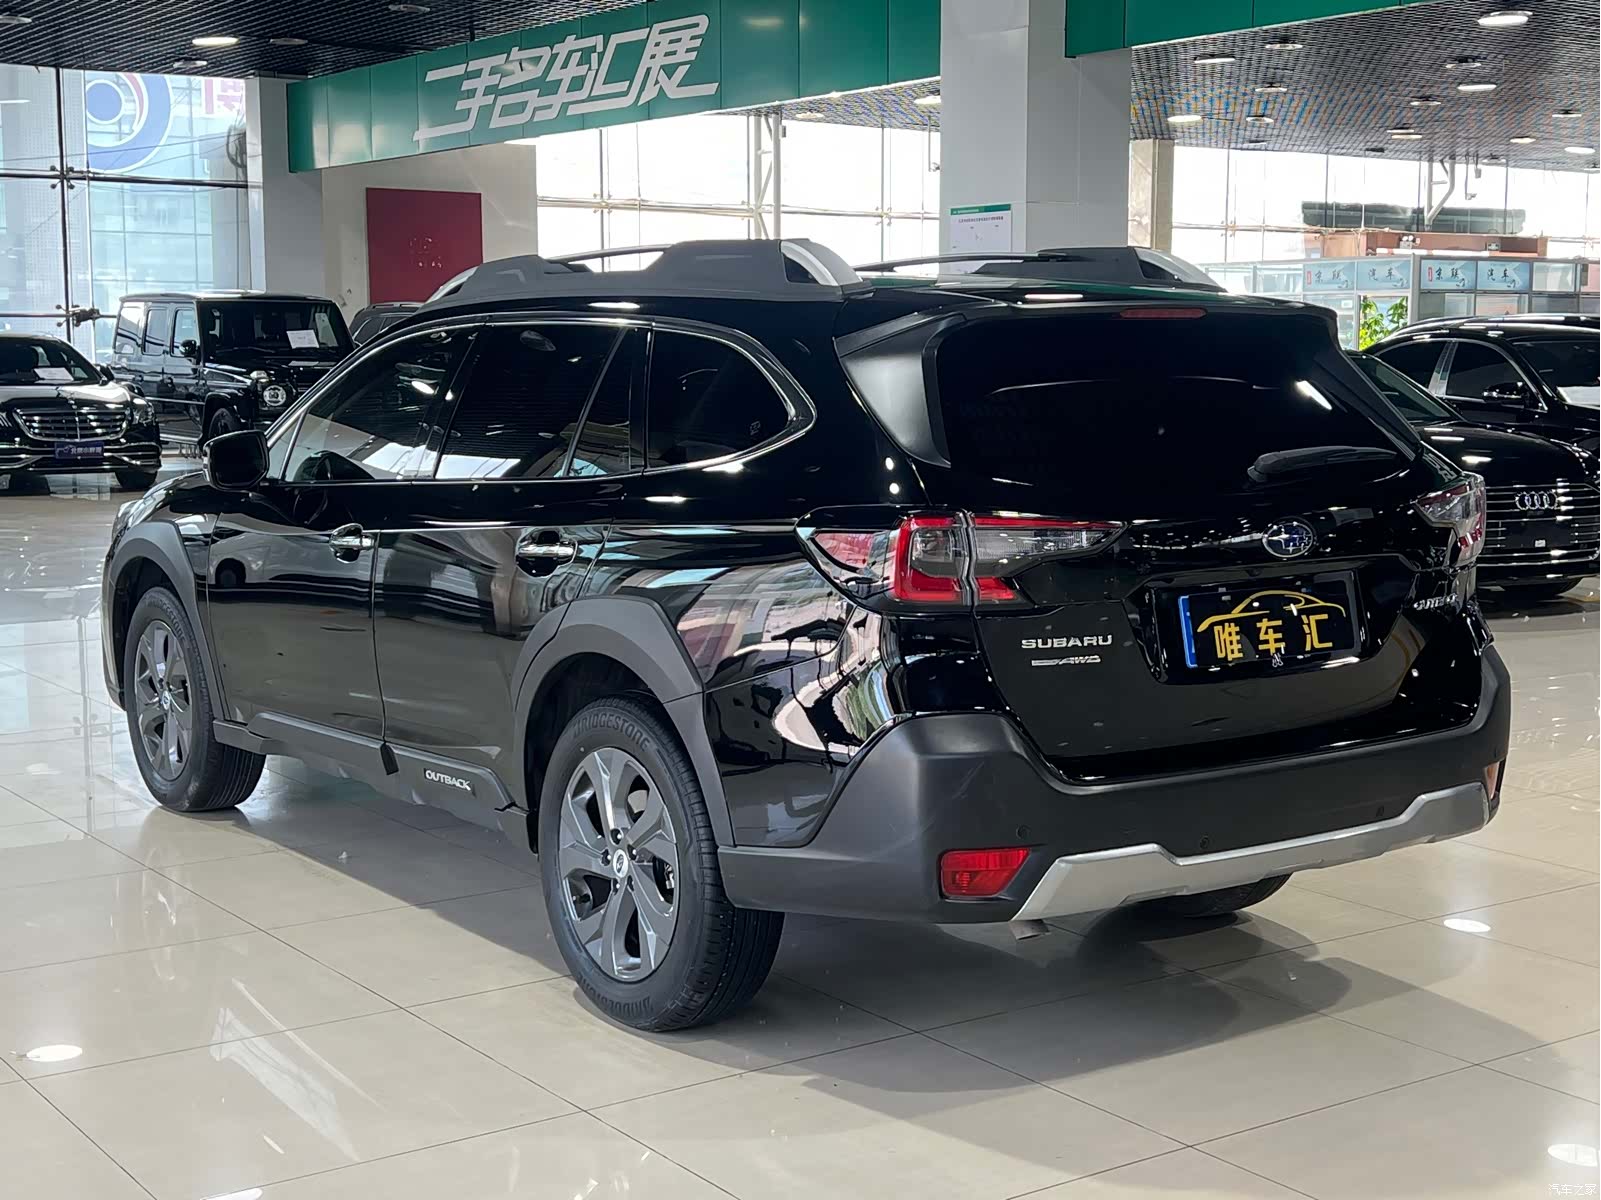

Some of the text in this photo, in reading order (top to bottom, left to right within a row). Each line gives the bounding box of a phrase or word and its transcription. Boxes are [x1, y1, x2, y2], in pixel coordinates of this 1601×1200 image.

[1021, 634, 1113, 649] SUBARU
[1213, 613, 1334, 661] 唯车汇
[425, 769, 472, 791] OUTBACK
